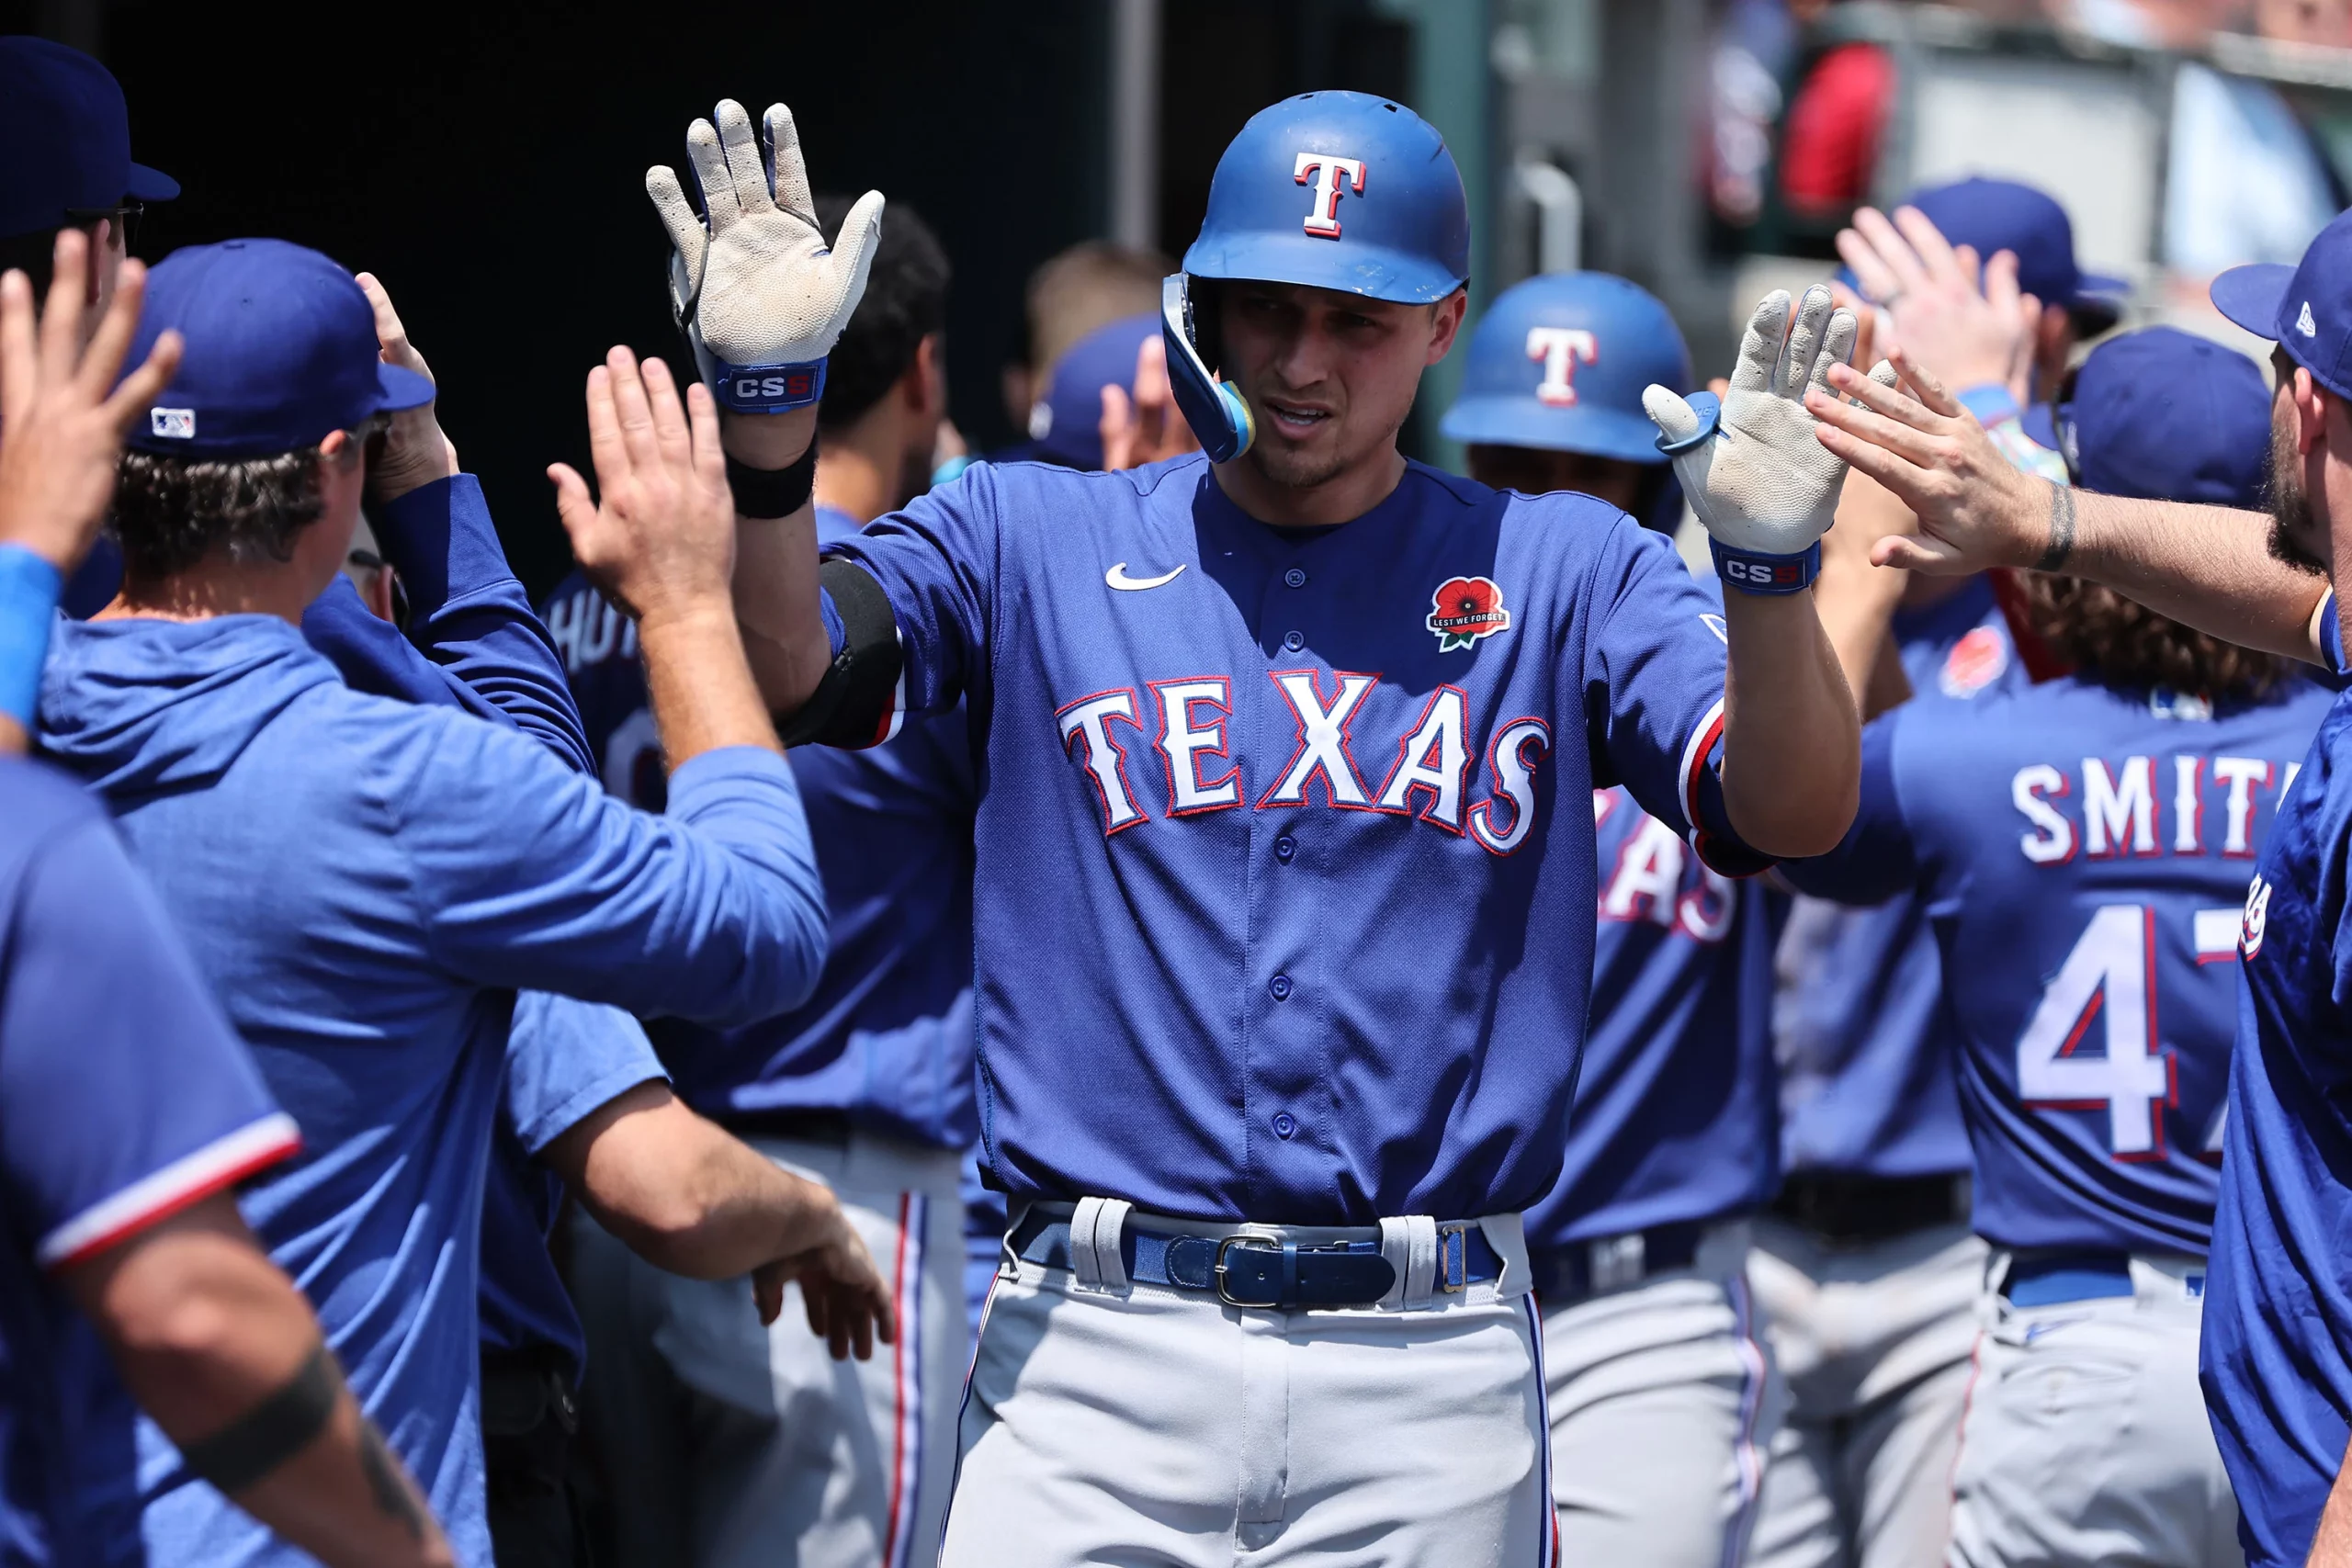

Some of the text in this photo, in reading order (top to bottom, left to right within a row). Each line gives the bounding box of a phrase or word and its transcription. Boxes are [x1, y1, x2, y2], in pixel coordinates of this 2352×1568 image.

[1294, 152, 1367, 237] T
[1526, 327, 1599, 409] T
[1433, 613, 1503, 626] LEST WE FORGET
[1055, 669, 1551, 857] TEXAS
[2011, 754, 2302, 866] SMIT
